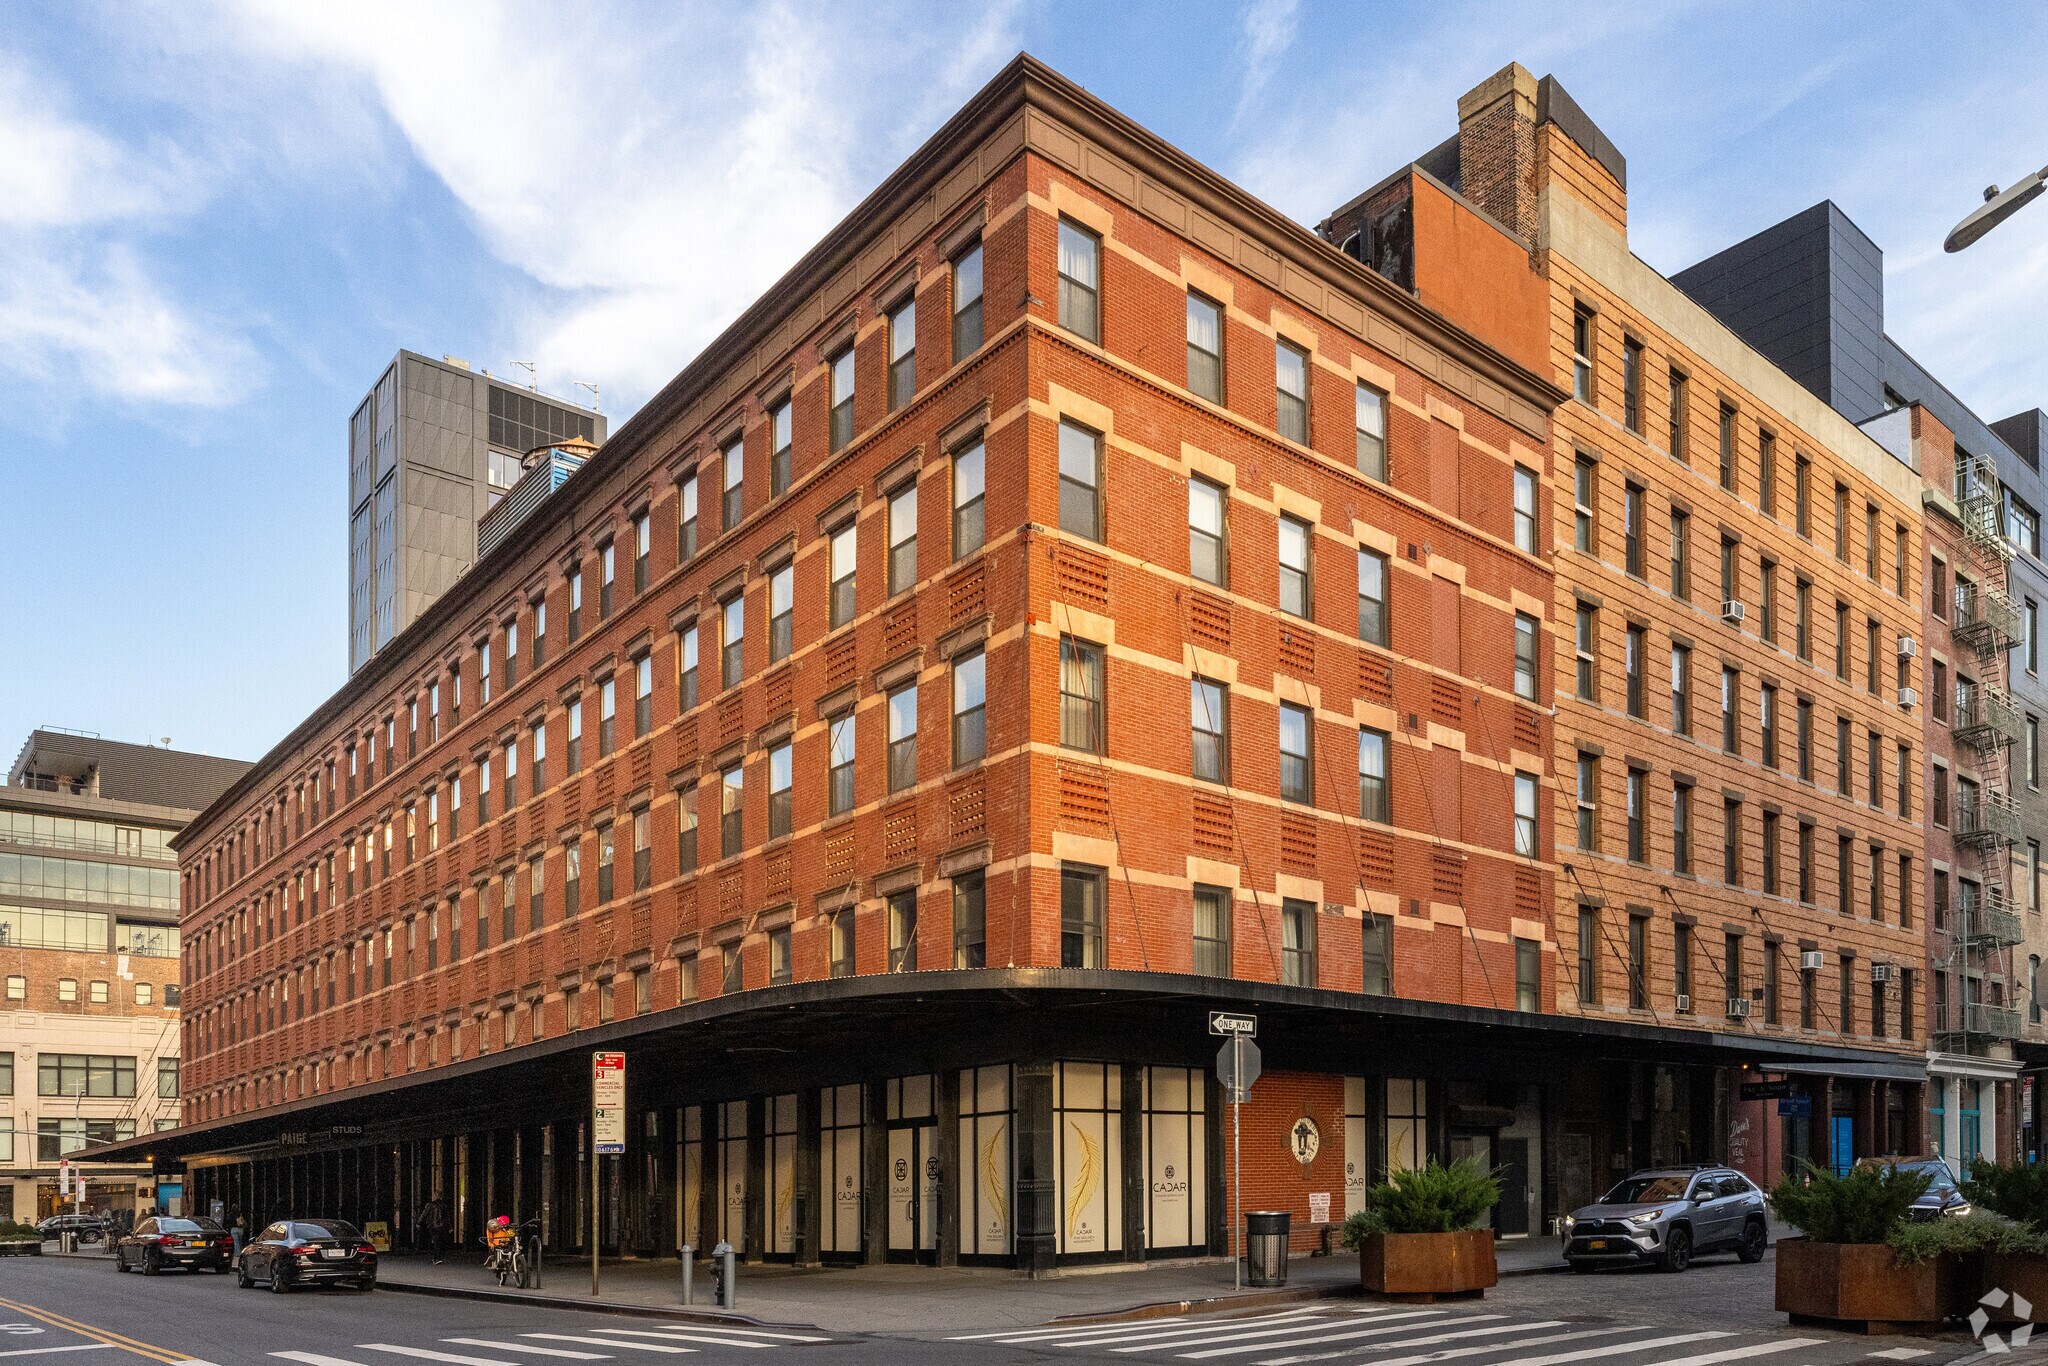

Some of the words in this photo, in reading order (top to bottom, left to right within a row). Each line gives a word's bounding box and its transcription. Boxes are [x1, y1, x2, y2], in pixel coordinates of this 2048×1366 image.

[1218, 1019, 1233, 1029] ONE
[1235, 1021, 1250, 1030] WAY
[596, 1070, 603, 1079] 3
[596, 1109, 603, 1118] 2
[332, 1125, 362, 1134] STUDS
[281, 1132, 308, 1145] PAIGE
[1345, 1177, 1365, 1187] ADAR
[892, 1186, 910, 1194] CADAR
[1153, 1182, 1187, 1193] CADAR
